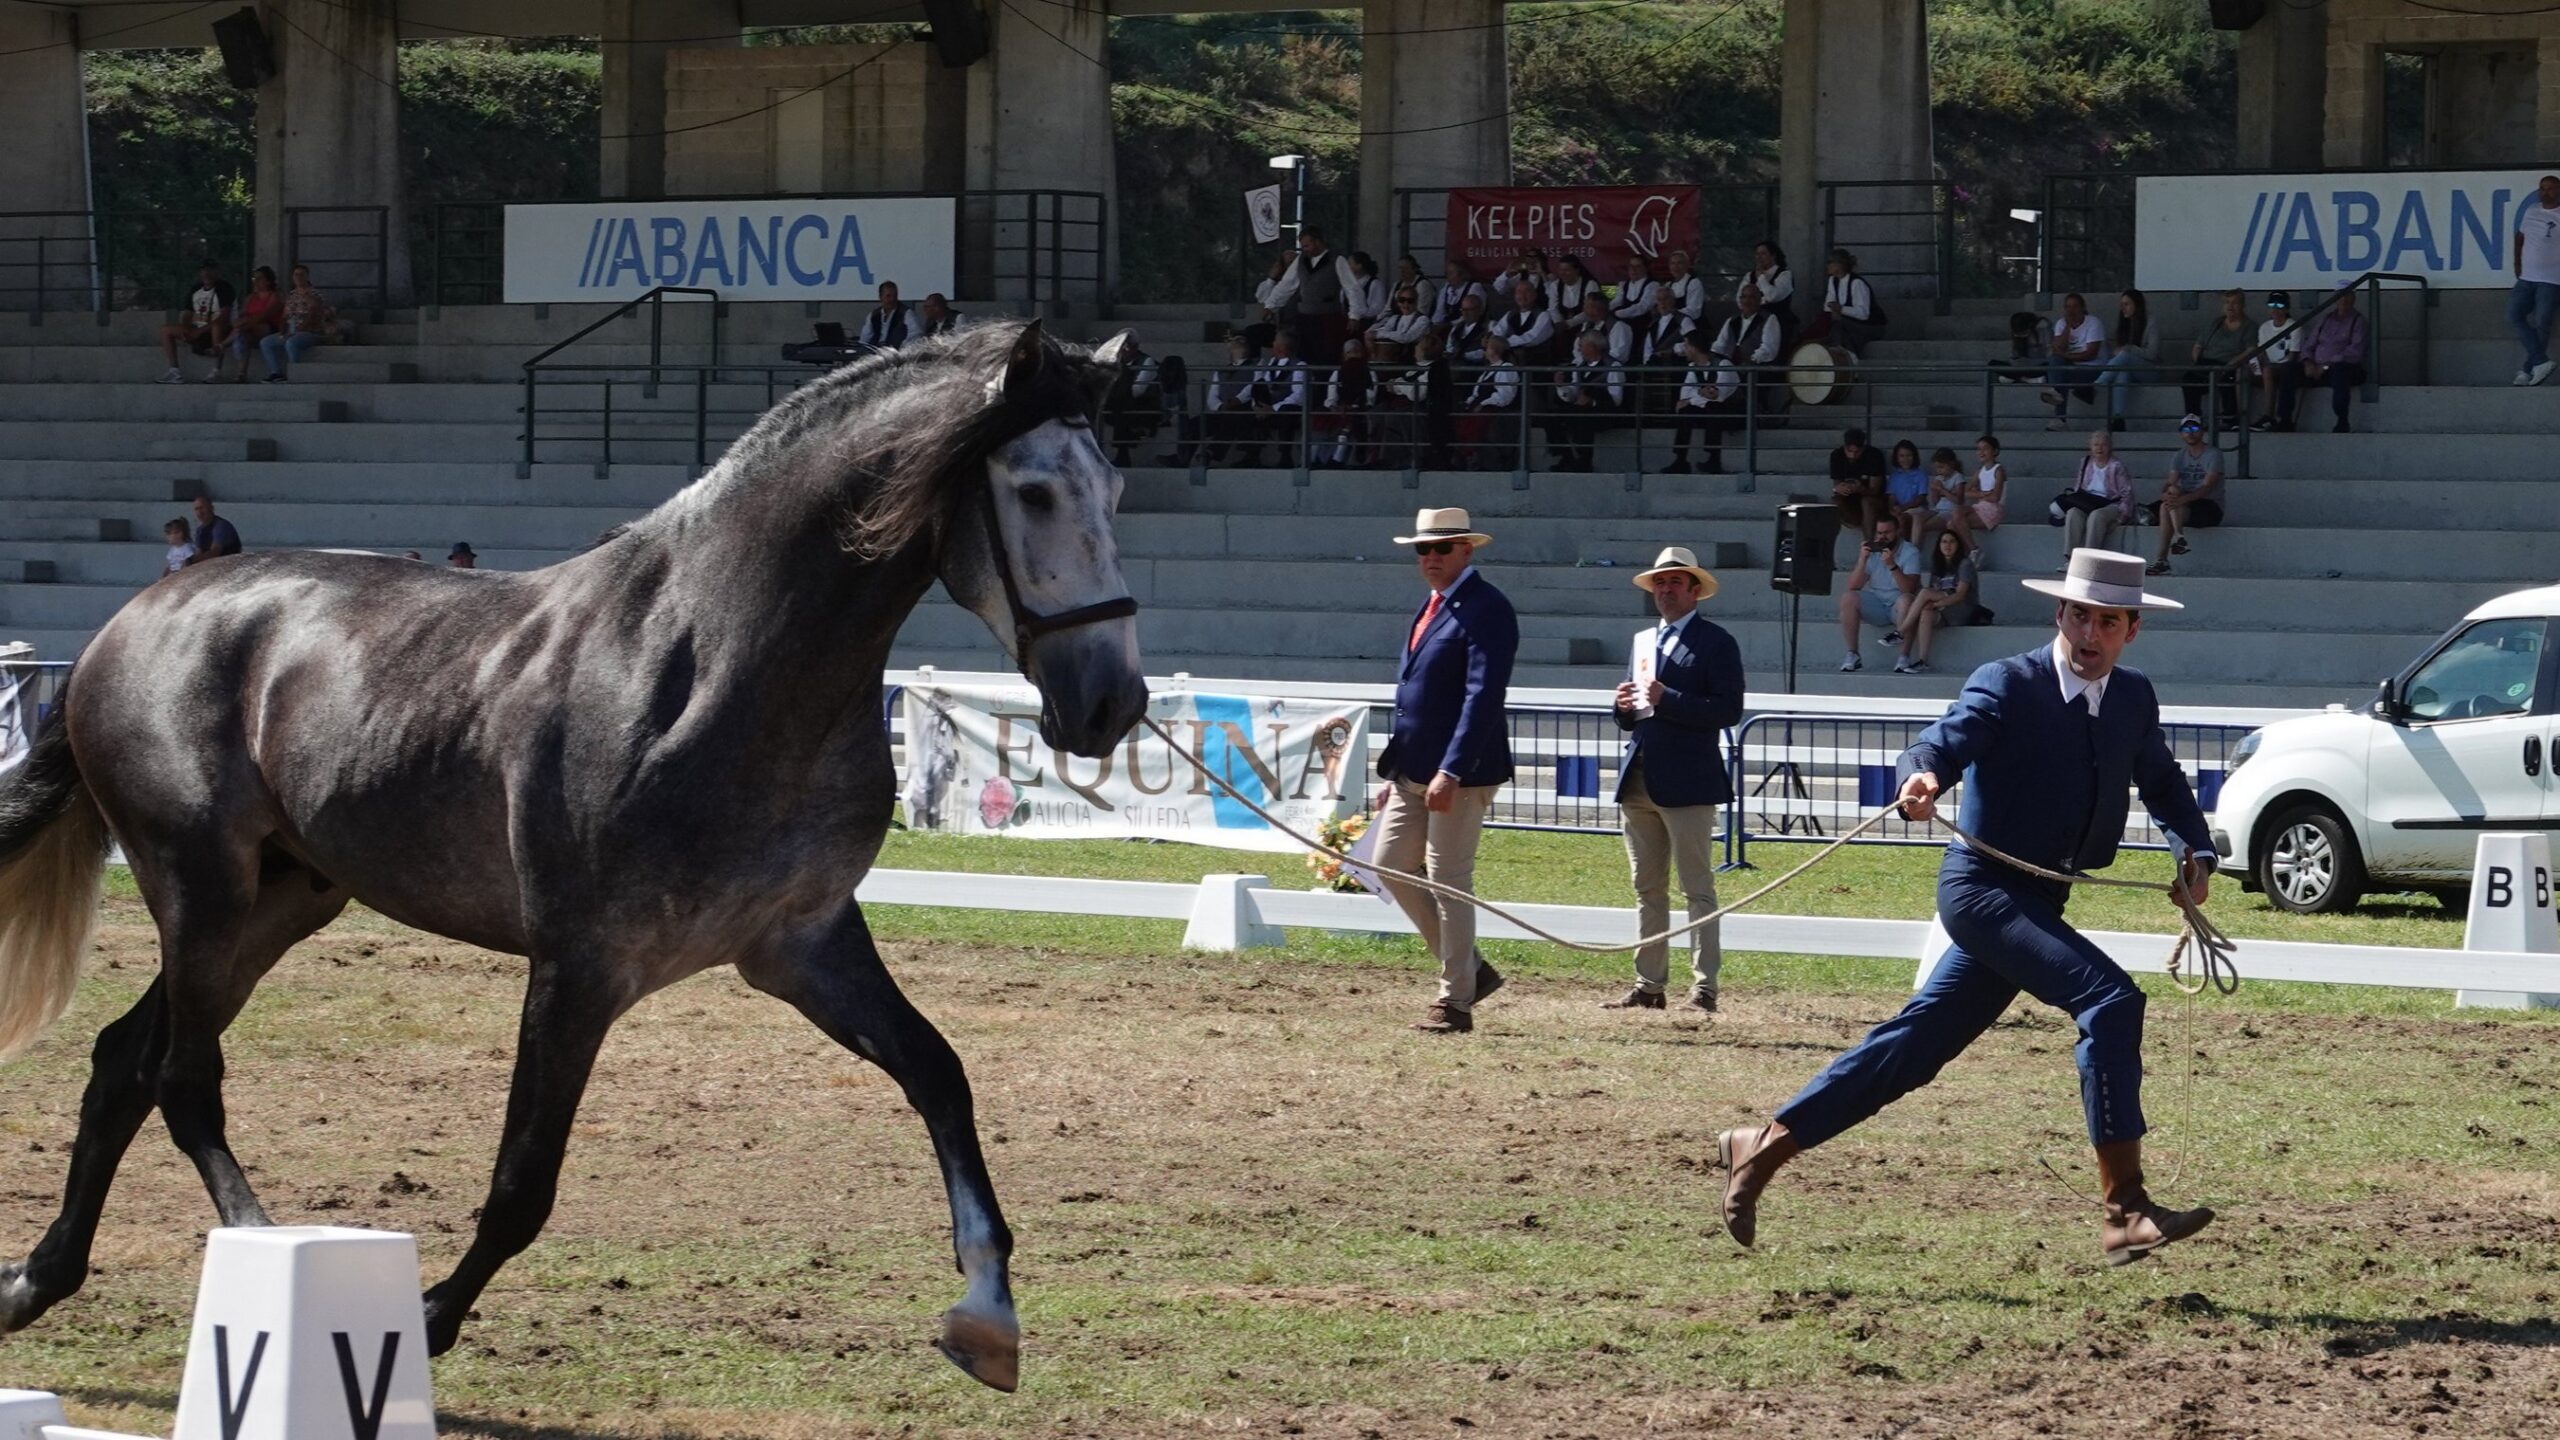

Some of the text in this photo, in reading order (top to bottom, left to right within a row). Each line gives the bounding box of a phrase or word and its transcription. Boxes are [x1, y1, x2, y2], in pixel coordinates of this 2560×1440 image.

[1467, 203, 1596, 241] KELPIES
[986, 711, 1346, 812] EQUINA
[2486, 866, 2513, 908] B
[2534, 866, 2549, 908] B
[213, 1324, 271, 1440] V
[330, 1331, 402, 1440] V
